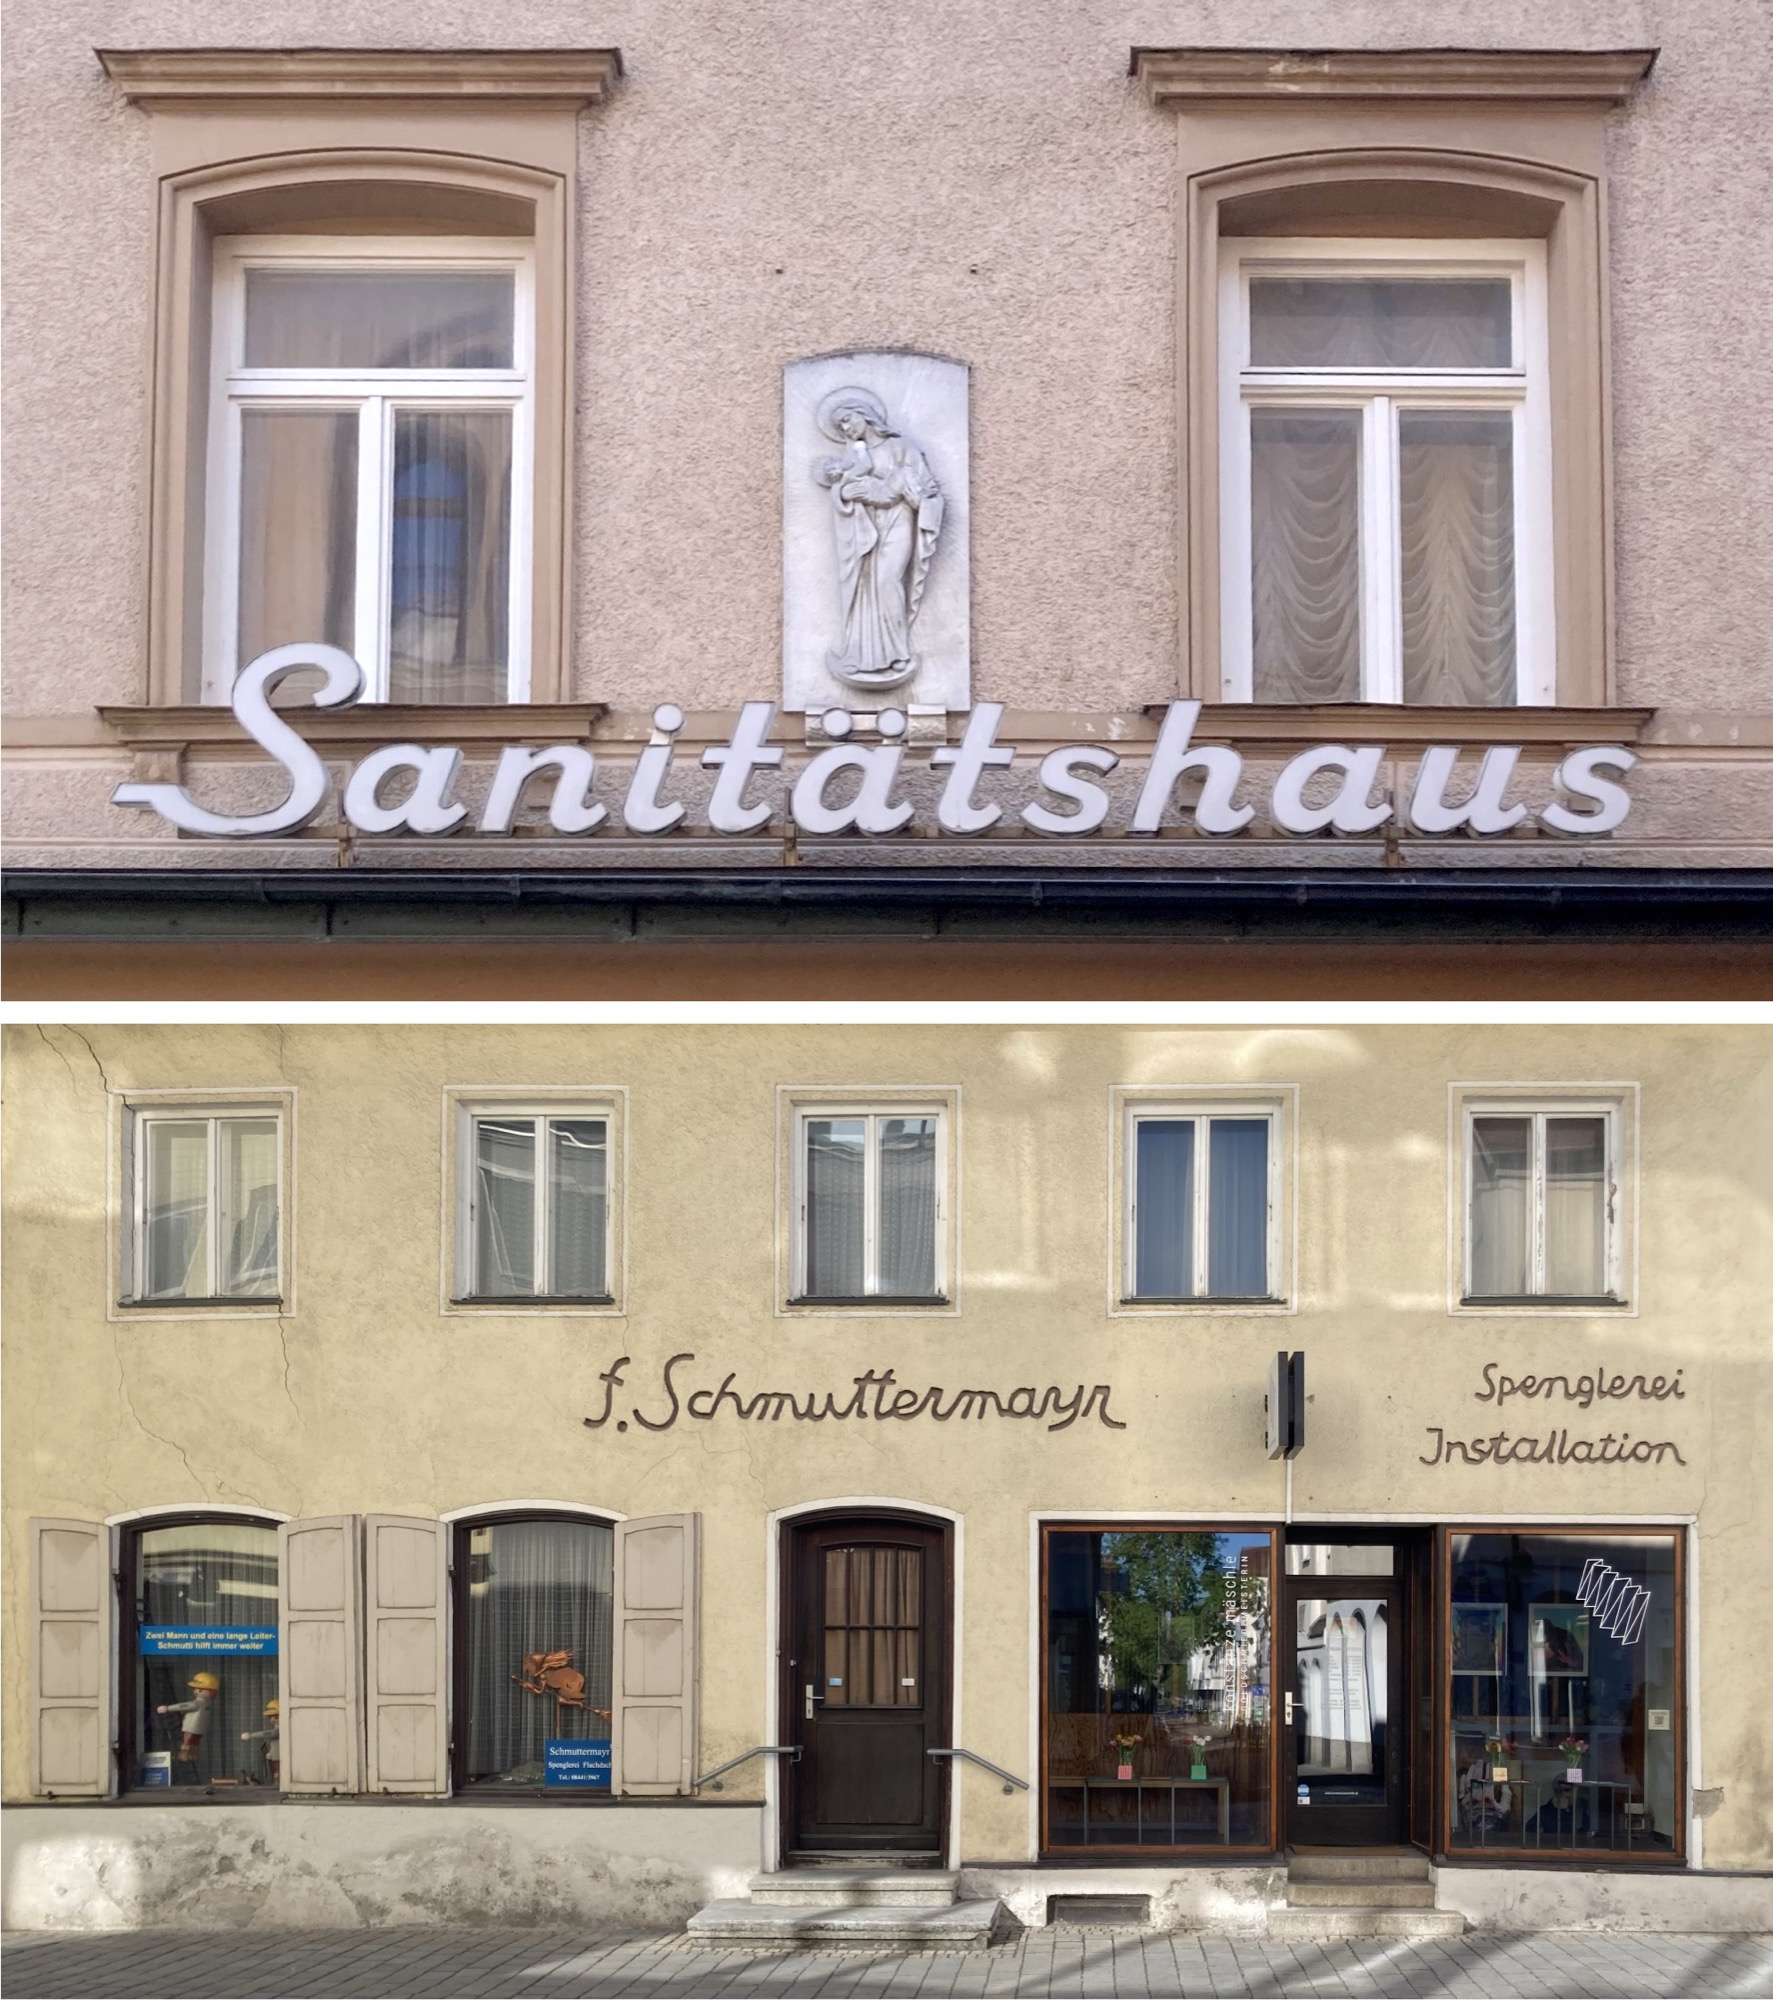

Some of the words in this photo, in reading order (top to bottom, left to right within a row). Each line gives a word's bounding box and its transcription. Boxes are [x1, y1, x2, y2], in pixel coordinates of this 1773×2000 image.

[111, 641, 1640, 840] Sanitätshaus
[632, 1353, 1127, 1432] Schmuttermayr
[1475, 1363, 1685, 1408] Spenglerei
[1419, 1428, 1687, 1465] Installation
[1222, 1555, 1237, 1622] mäschle
[145, 1632, 165, 1640] Zwei
[166, 1632, 188, 1640] Mann
[190, 1632, 206, 1640] und
[207, 1632, 224, 1640] eine
[226, 1632, 248, 1642] lange
[157, 1641, 193, 1650] Schmutti
[195, 1641, 211, 1650] hilft
[212, 1641, 237, 1650] immer
[239, 1641, 264, 1650] weiter
[548, 1761, 580, 1770] Spenglerei
[549, 1746, 610, 1758] Schmuttermayr
